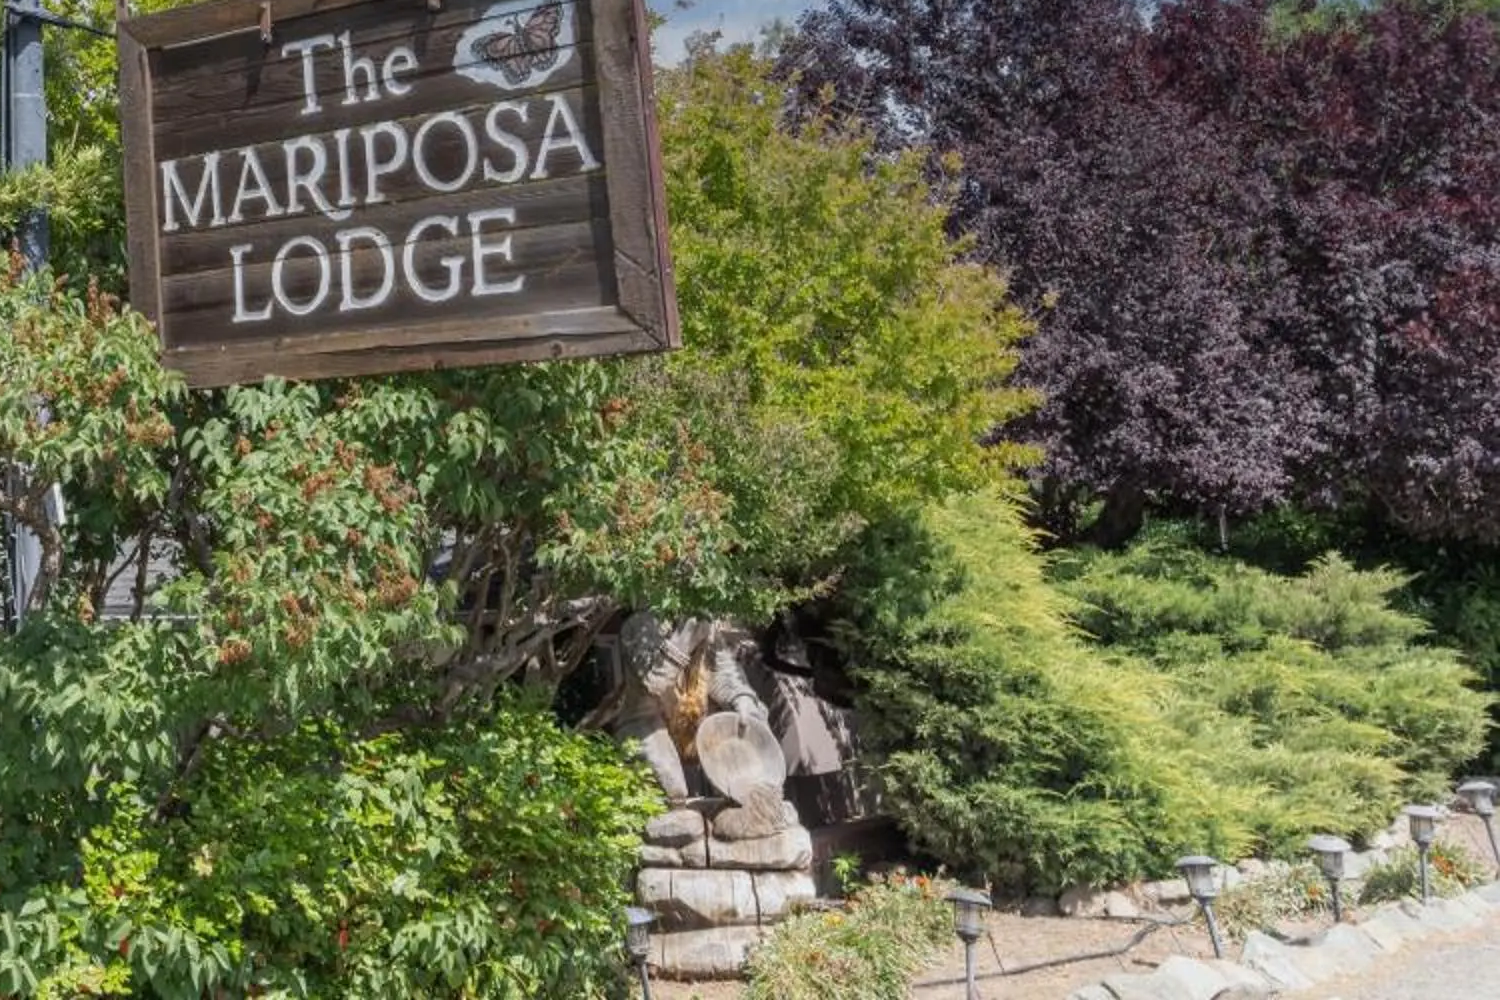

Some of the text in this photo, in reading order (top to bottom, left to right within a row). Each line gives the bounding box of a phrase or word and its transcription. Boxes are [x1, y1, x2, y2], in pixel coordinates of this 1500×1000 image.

[281, 28, 418, 116] The
[160, 92, 602, 232] MARIPOSA
[229, 207, 524, 323] LODGE
